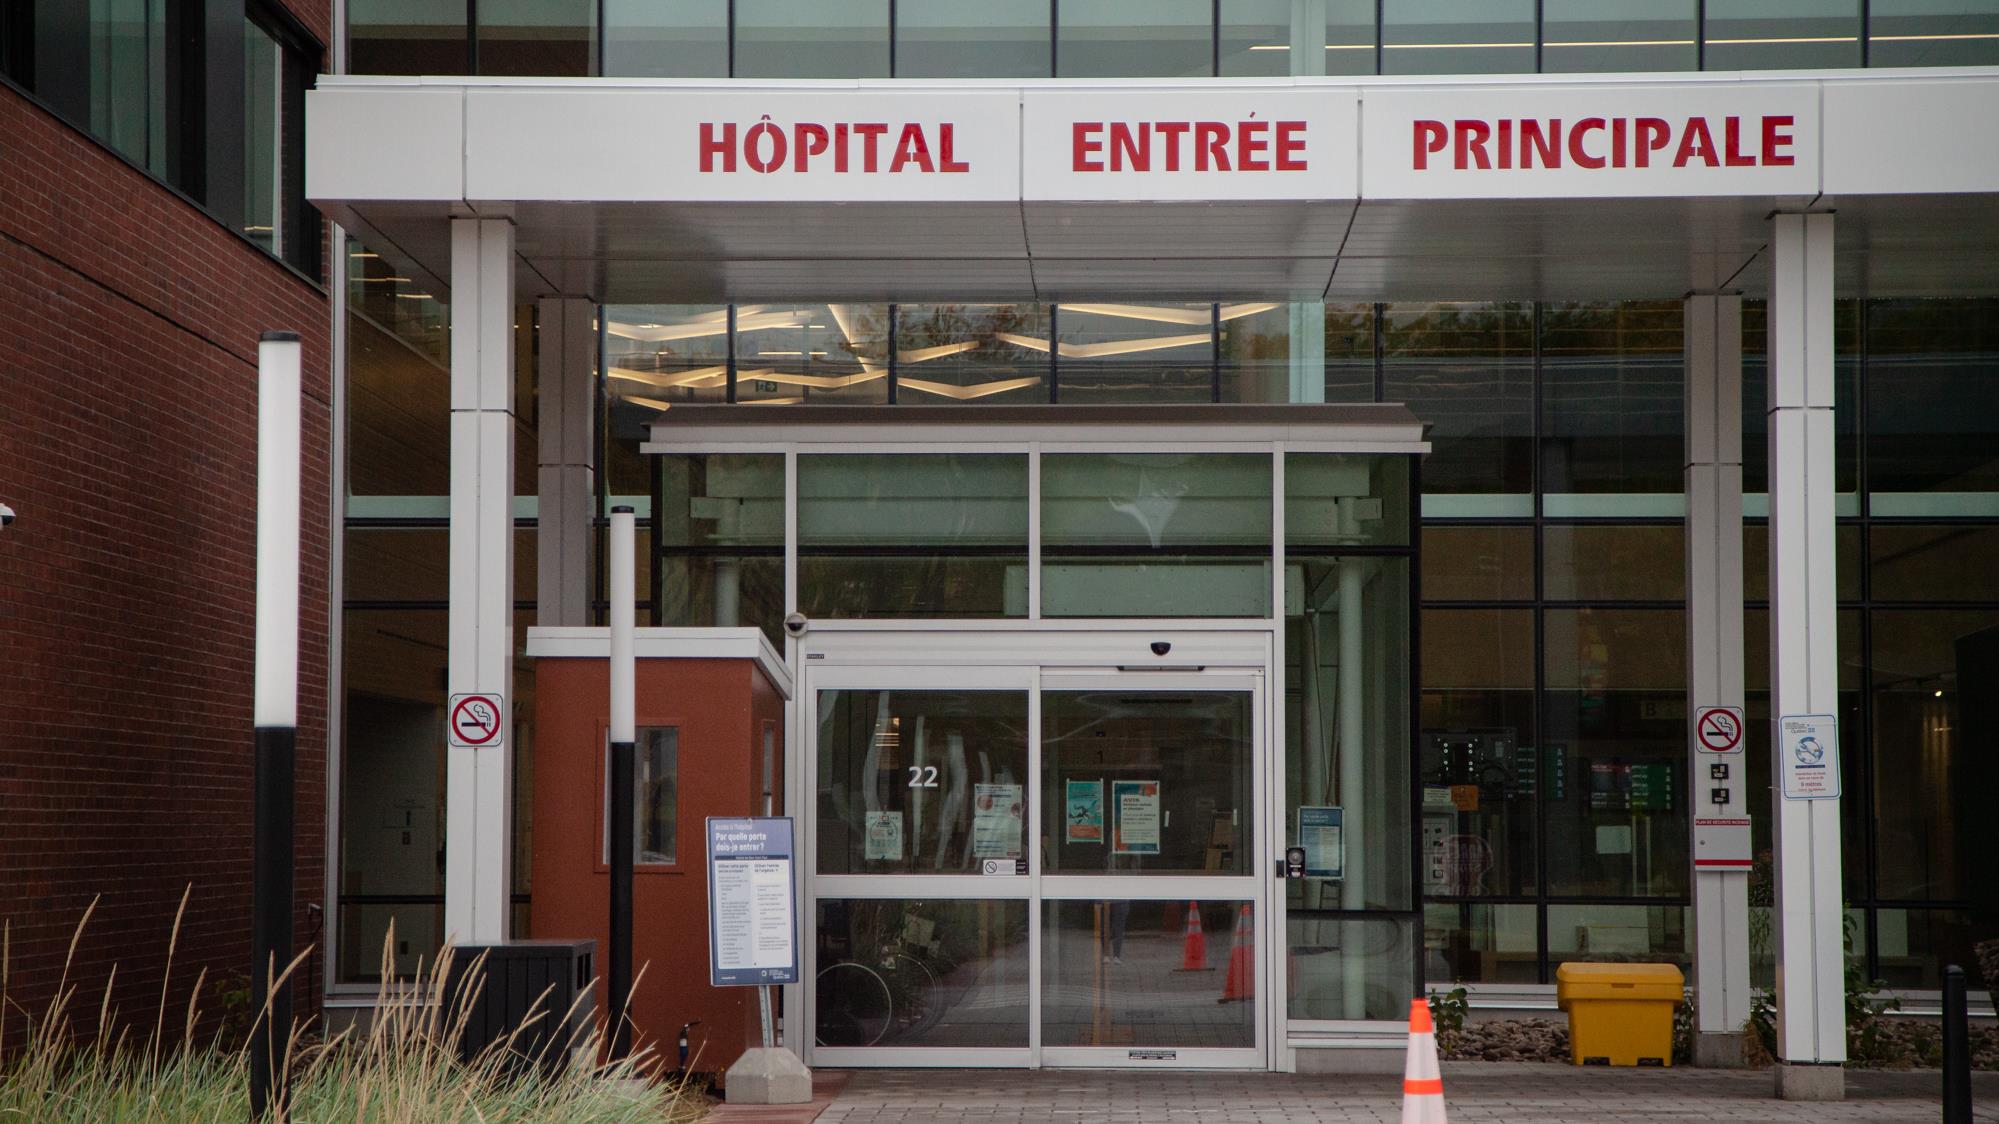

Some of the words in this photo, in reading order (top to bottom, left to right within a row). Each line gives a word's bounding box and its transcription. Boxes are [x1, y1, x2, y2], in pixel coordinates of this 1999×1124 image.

[700, 114, 970, 174] HÔPITAL
[1072, 112, 1307, 173] ENTRÉE
[1413, 116, 1795, 171] PRINCIPALE
[908, 766, 938, 787] 22
